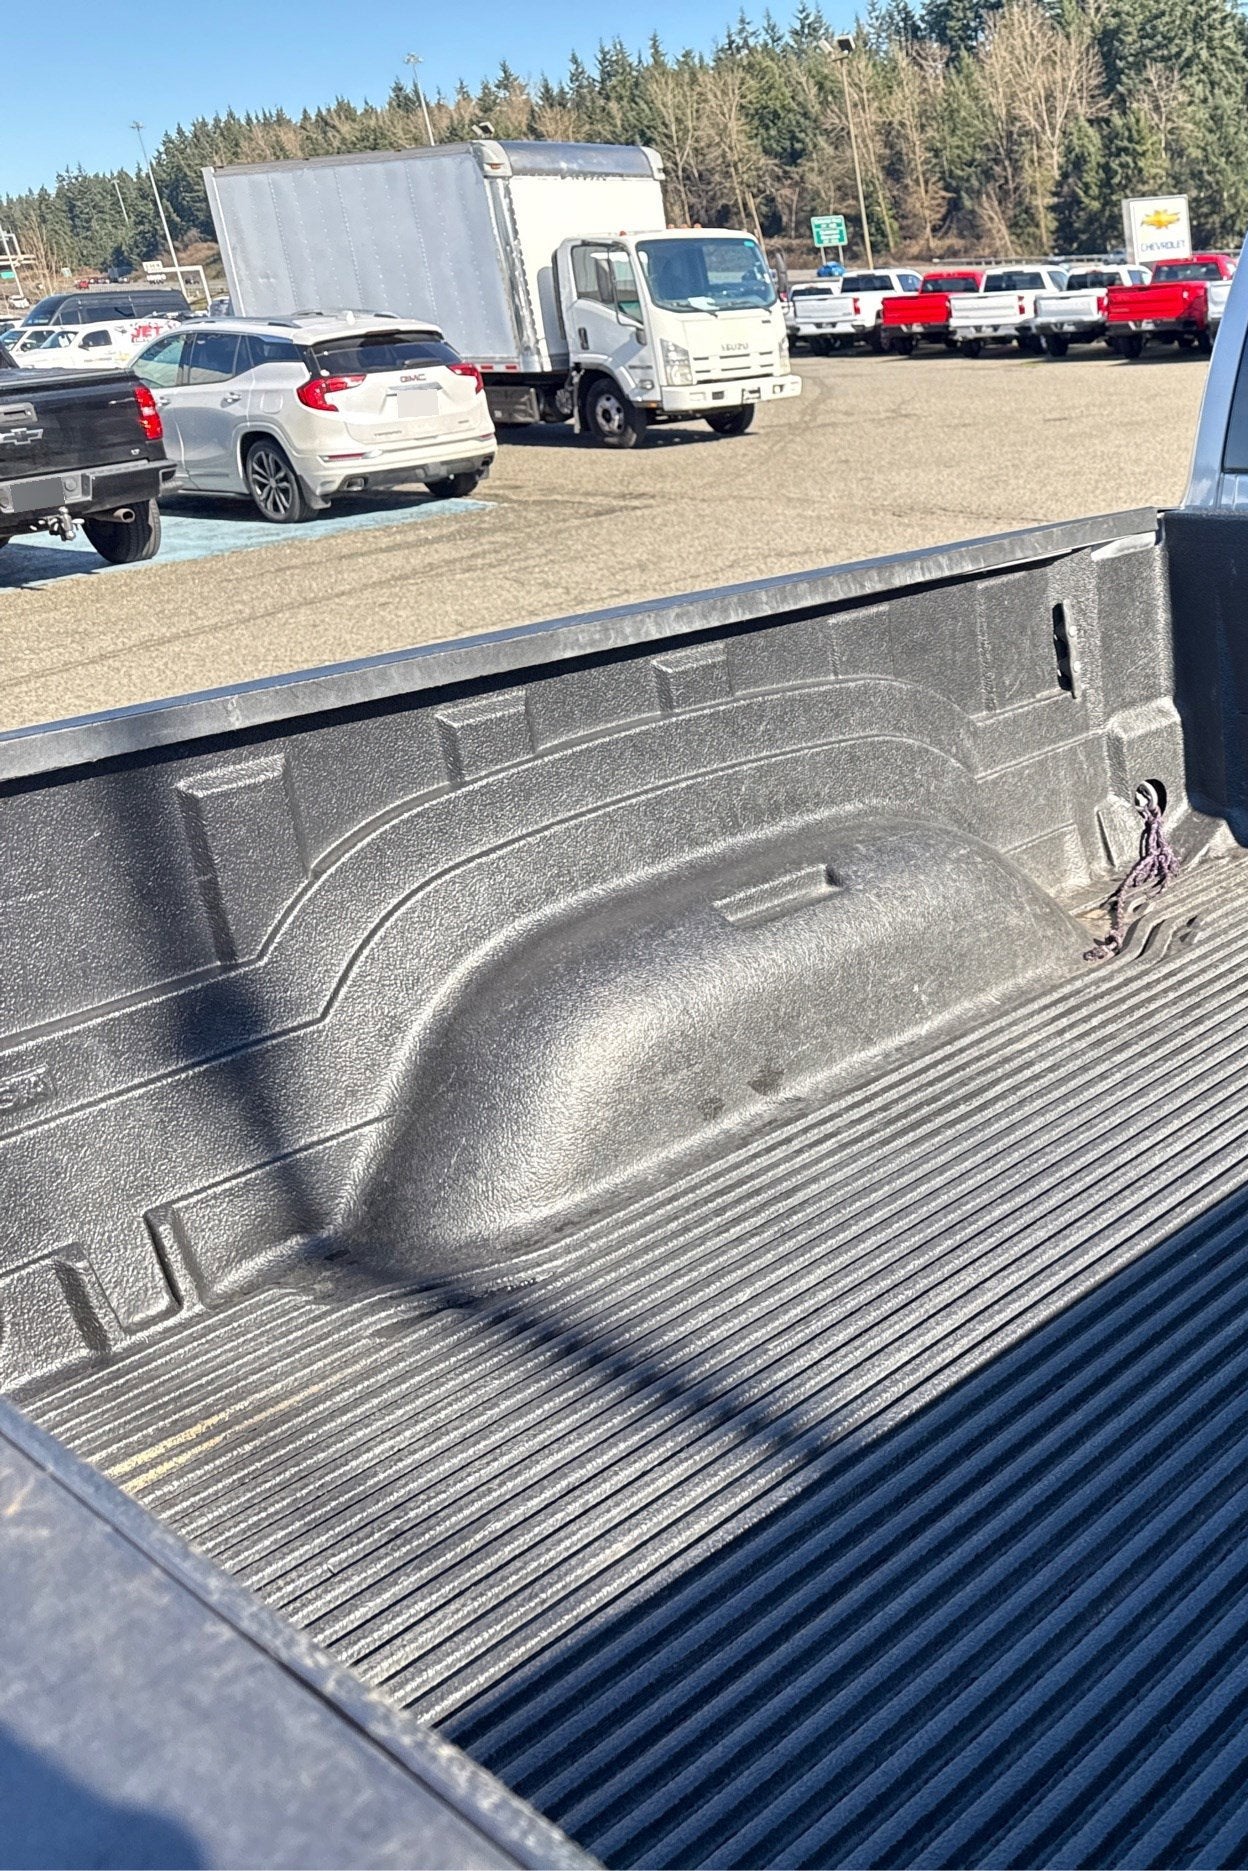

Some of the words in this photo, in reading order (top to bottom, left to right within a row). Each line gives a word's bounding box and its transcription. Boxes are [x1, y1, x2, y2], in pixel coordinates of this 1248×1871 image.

[1140, 240, 1186, 252] CHEVROLET
[131, 325, 163, 338] JET
[400, 374, 426, 382] GMC
